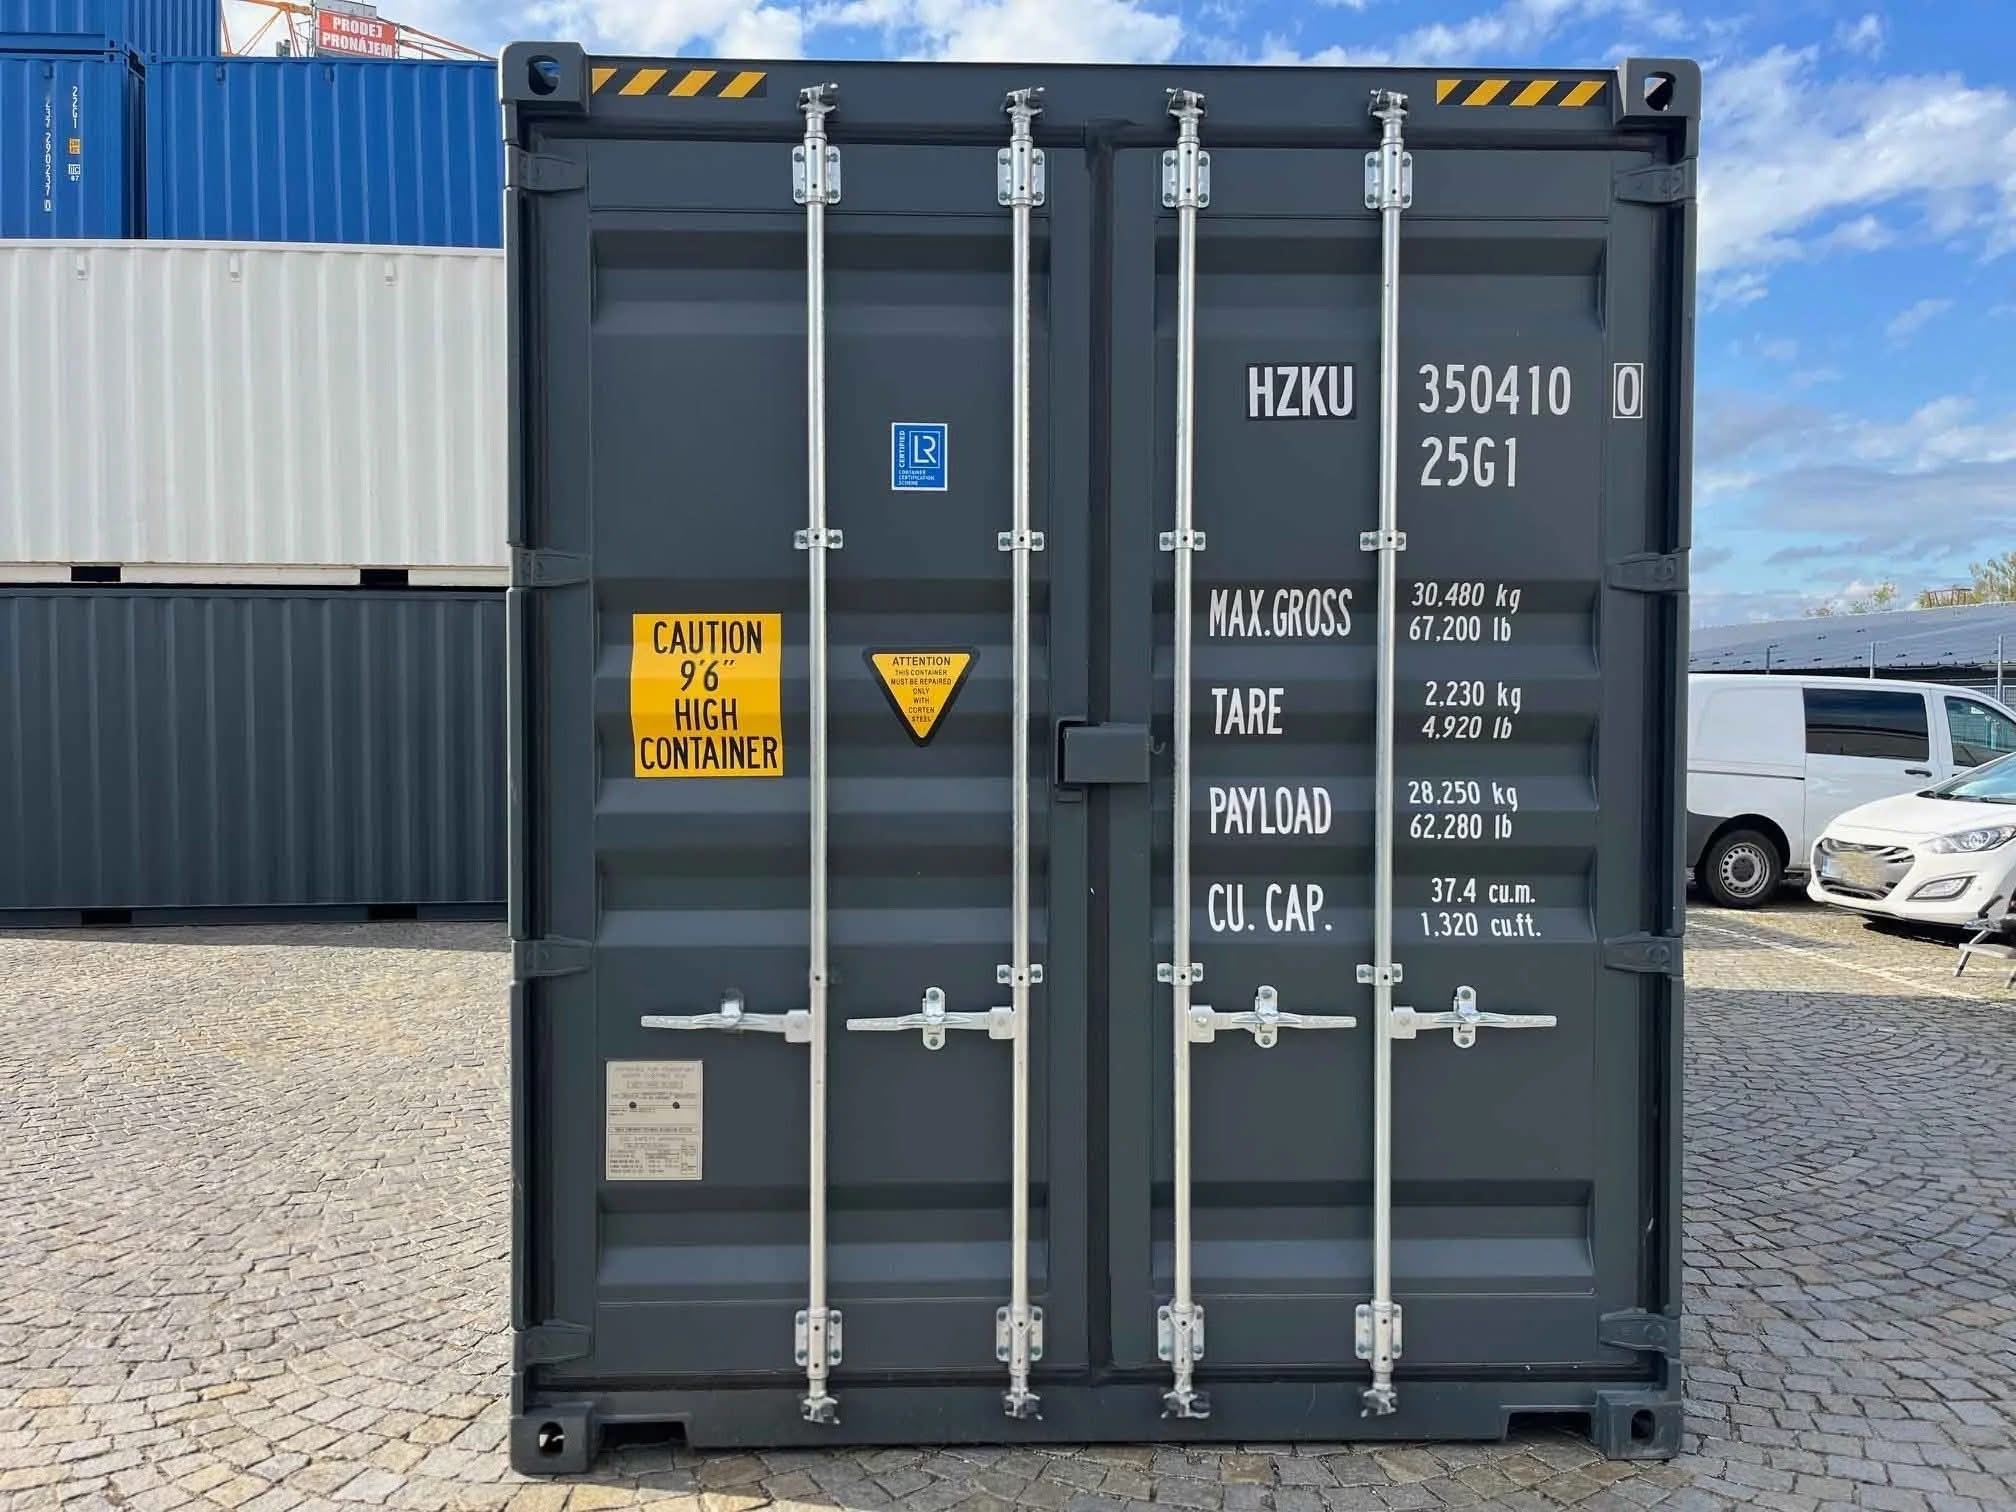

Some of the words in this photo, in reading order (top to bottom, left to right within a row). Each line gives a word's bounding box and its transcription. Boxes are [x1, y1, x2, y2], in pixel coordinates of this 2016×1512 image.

[333, 13, 382, 38] PRODEJ
[322, 32, 393, 56] PRONÁJEM
[1249, 366, 1353, 417] HZKU
[1418, 363, 1571, 415] 350410
[1617, 366, 1640, 416] 0
[914, 435, 937, 463] LR
[1420, 436, 1517, 488] 25G1
[1209, 588, 1353, 637] MAX.GROSS
[1495, 583, 1521, 614] kg
[653, 620, 762, 654] CAUTION
[1493, 616, 1512, 642] lb
[892, 656, 951, 666] ATTENTION
[890, 678, 908, 686] MUST
[919, 678, 952, 686] REPAIRED
[908, 706, 935, 714] CORTEN
[1211, 687, 1285, 735] TARE
[1497, 681, 1521, 714] kg
[675, 698, 738, 731] HIGH
[1493, 716, 1512, 739] lb
[640, 736, 778, 770] CONTAINER
[1209, 786, 1332, 835] PAYLOAD
[1492, 782, 1518, 812] kg
[1494, 813, 1512, 840] lb
[1431, 877, 1477, 903] 37.4
[1488, 883, 1536, 904] cu.m.
[1208, 883, 1256, 933] CU.
[1265, 883, 1333, 933] CAP.
[1490, 913, 1542, 937] cu.ft.
